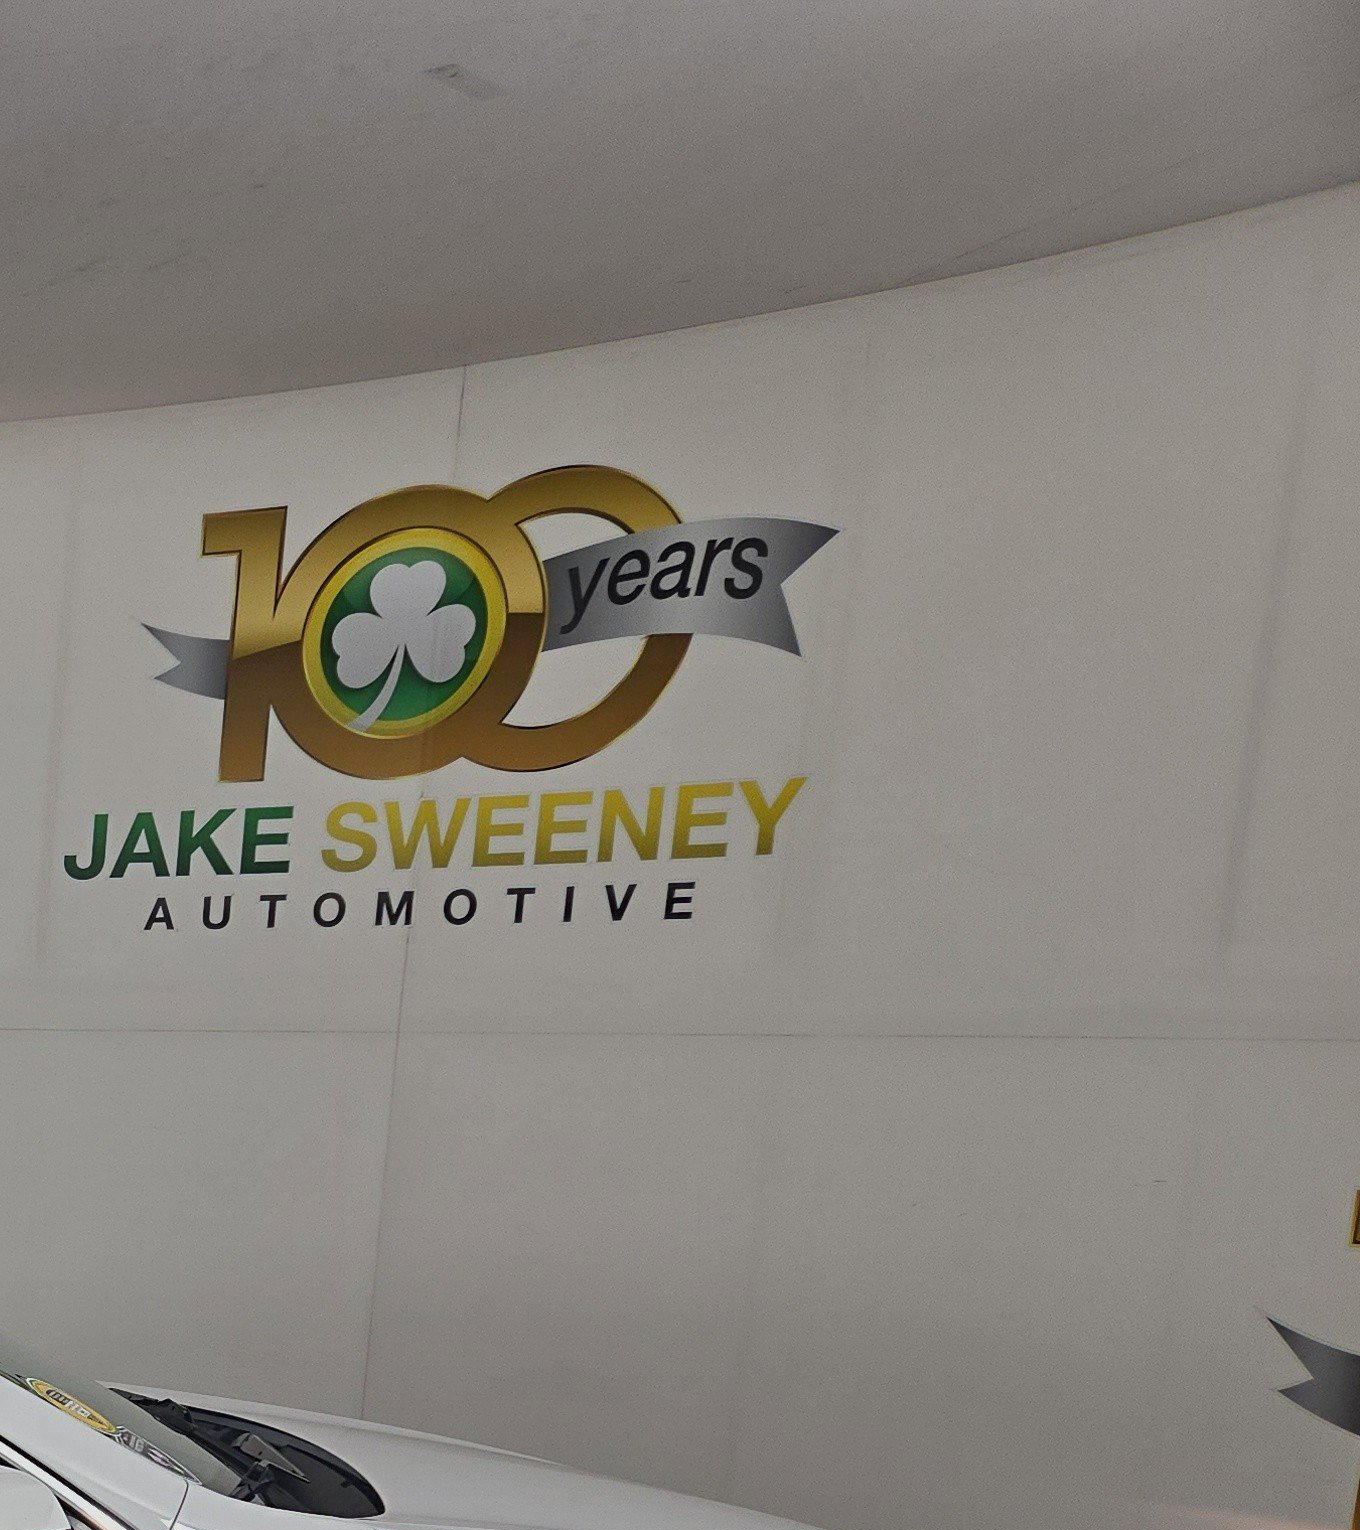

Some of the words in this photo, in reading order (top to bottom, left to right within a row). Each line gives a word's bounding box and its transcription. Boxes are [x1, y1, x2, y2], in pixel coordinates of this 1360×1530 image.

[559, 535, 769, 635] years
[63, 805, 294, 880] JAKE
[320, 776, 807, 873] SWEENEY
[144, 881, 696, 931] AUTOMOTIVE
